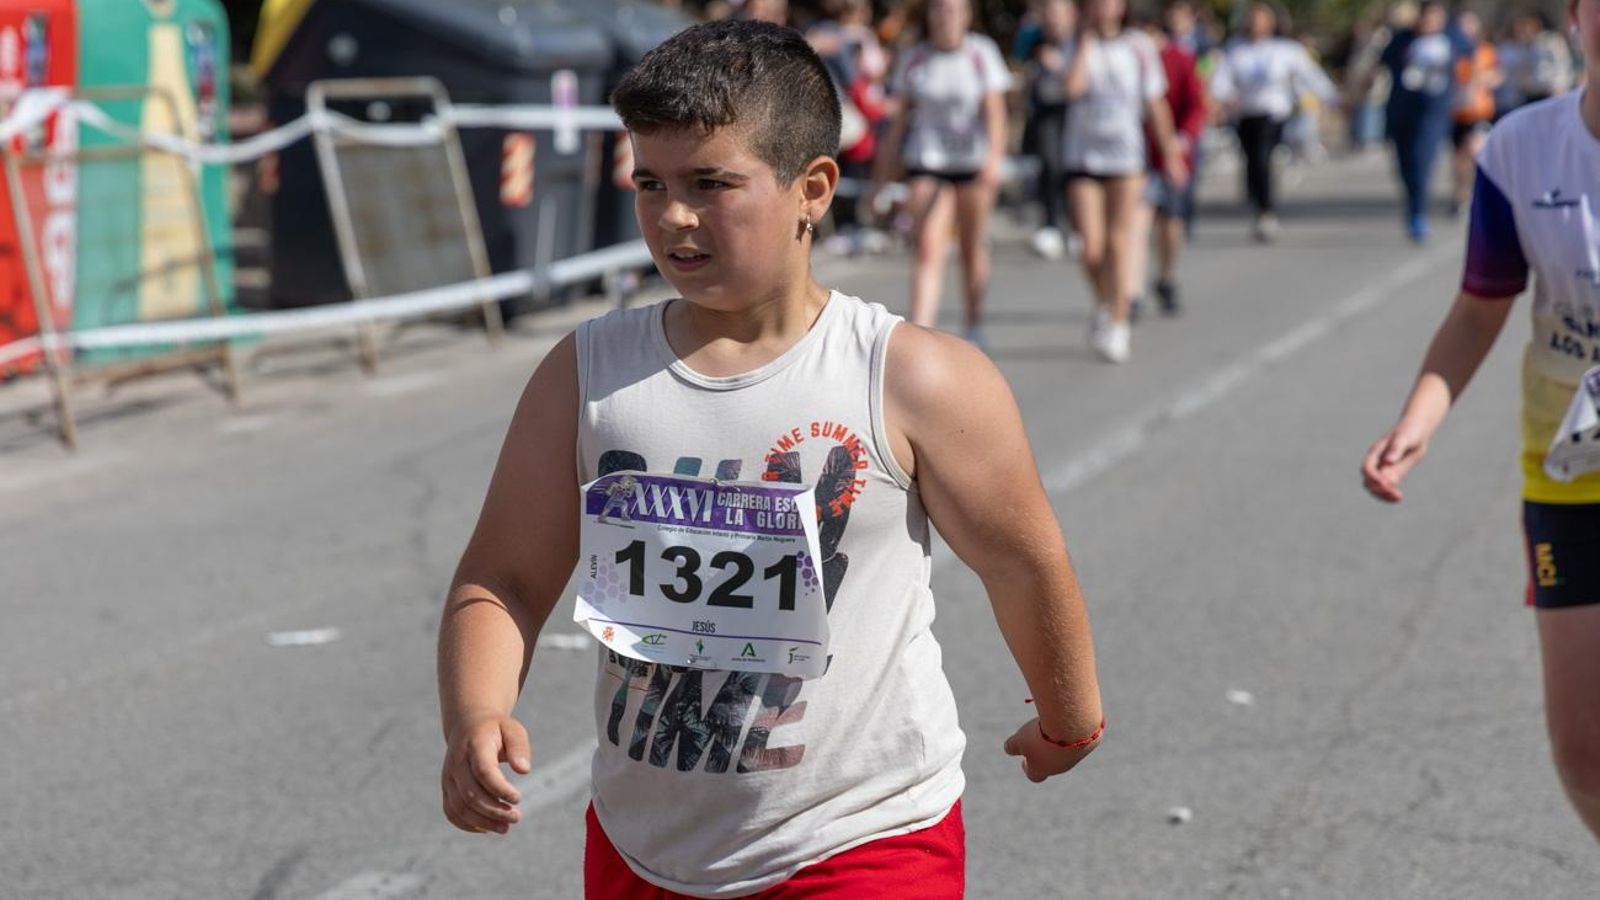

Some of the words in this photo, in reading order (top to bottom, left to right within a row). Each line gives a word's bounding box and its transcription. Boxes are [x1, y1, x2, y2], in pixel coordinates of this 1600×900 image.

[811, 421, 868, 471] SUMMER
[631, 481, 715, 522] XXXVI
[716, 492, 770, 512] CARRERA
[725, 508, 744, 526] LA
[615, 539, 797, 611] 1321
[692, 620, 716, 633] JESÚS
